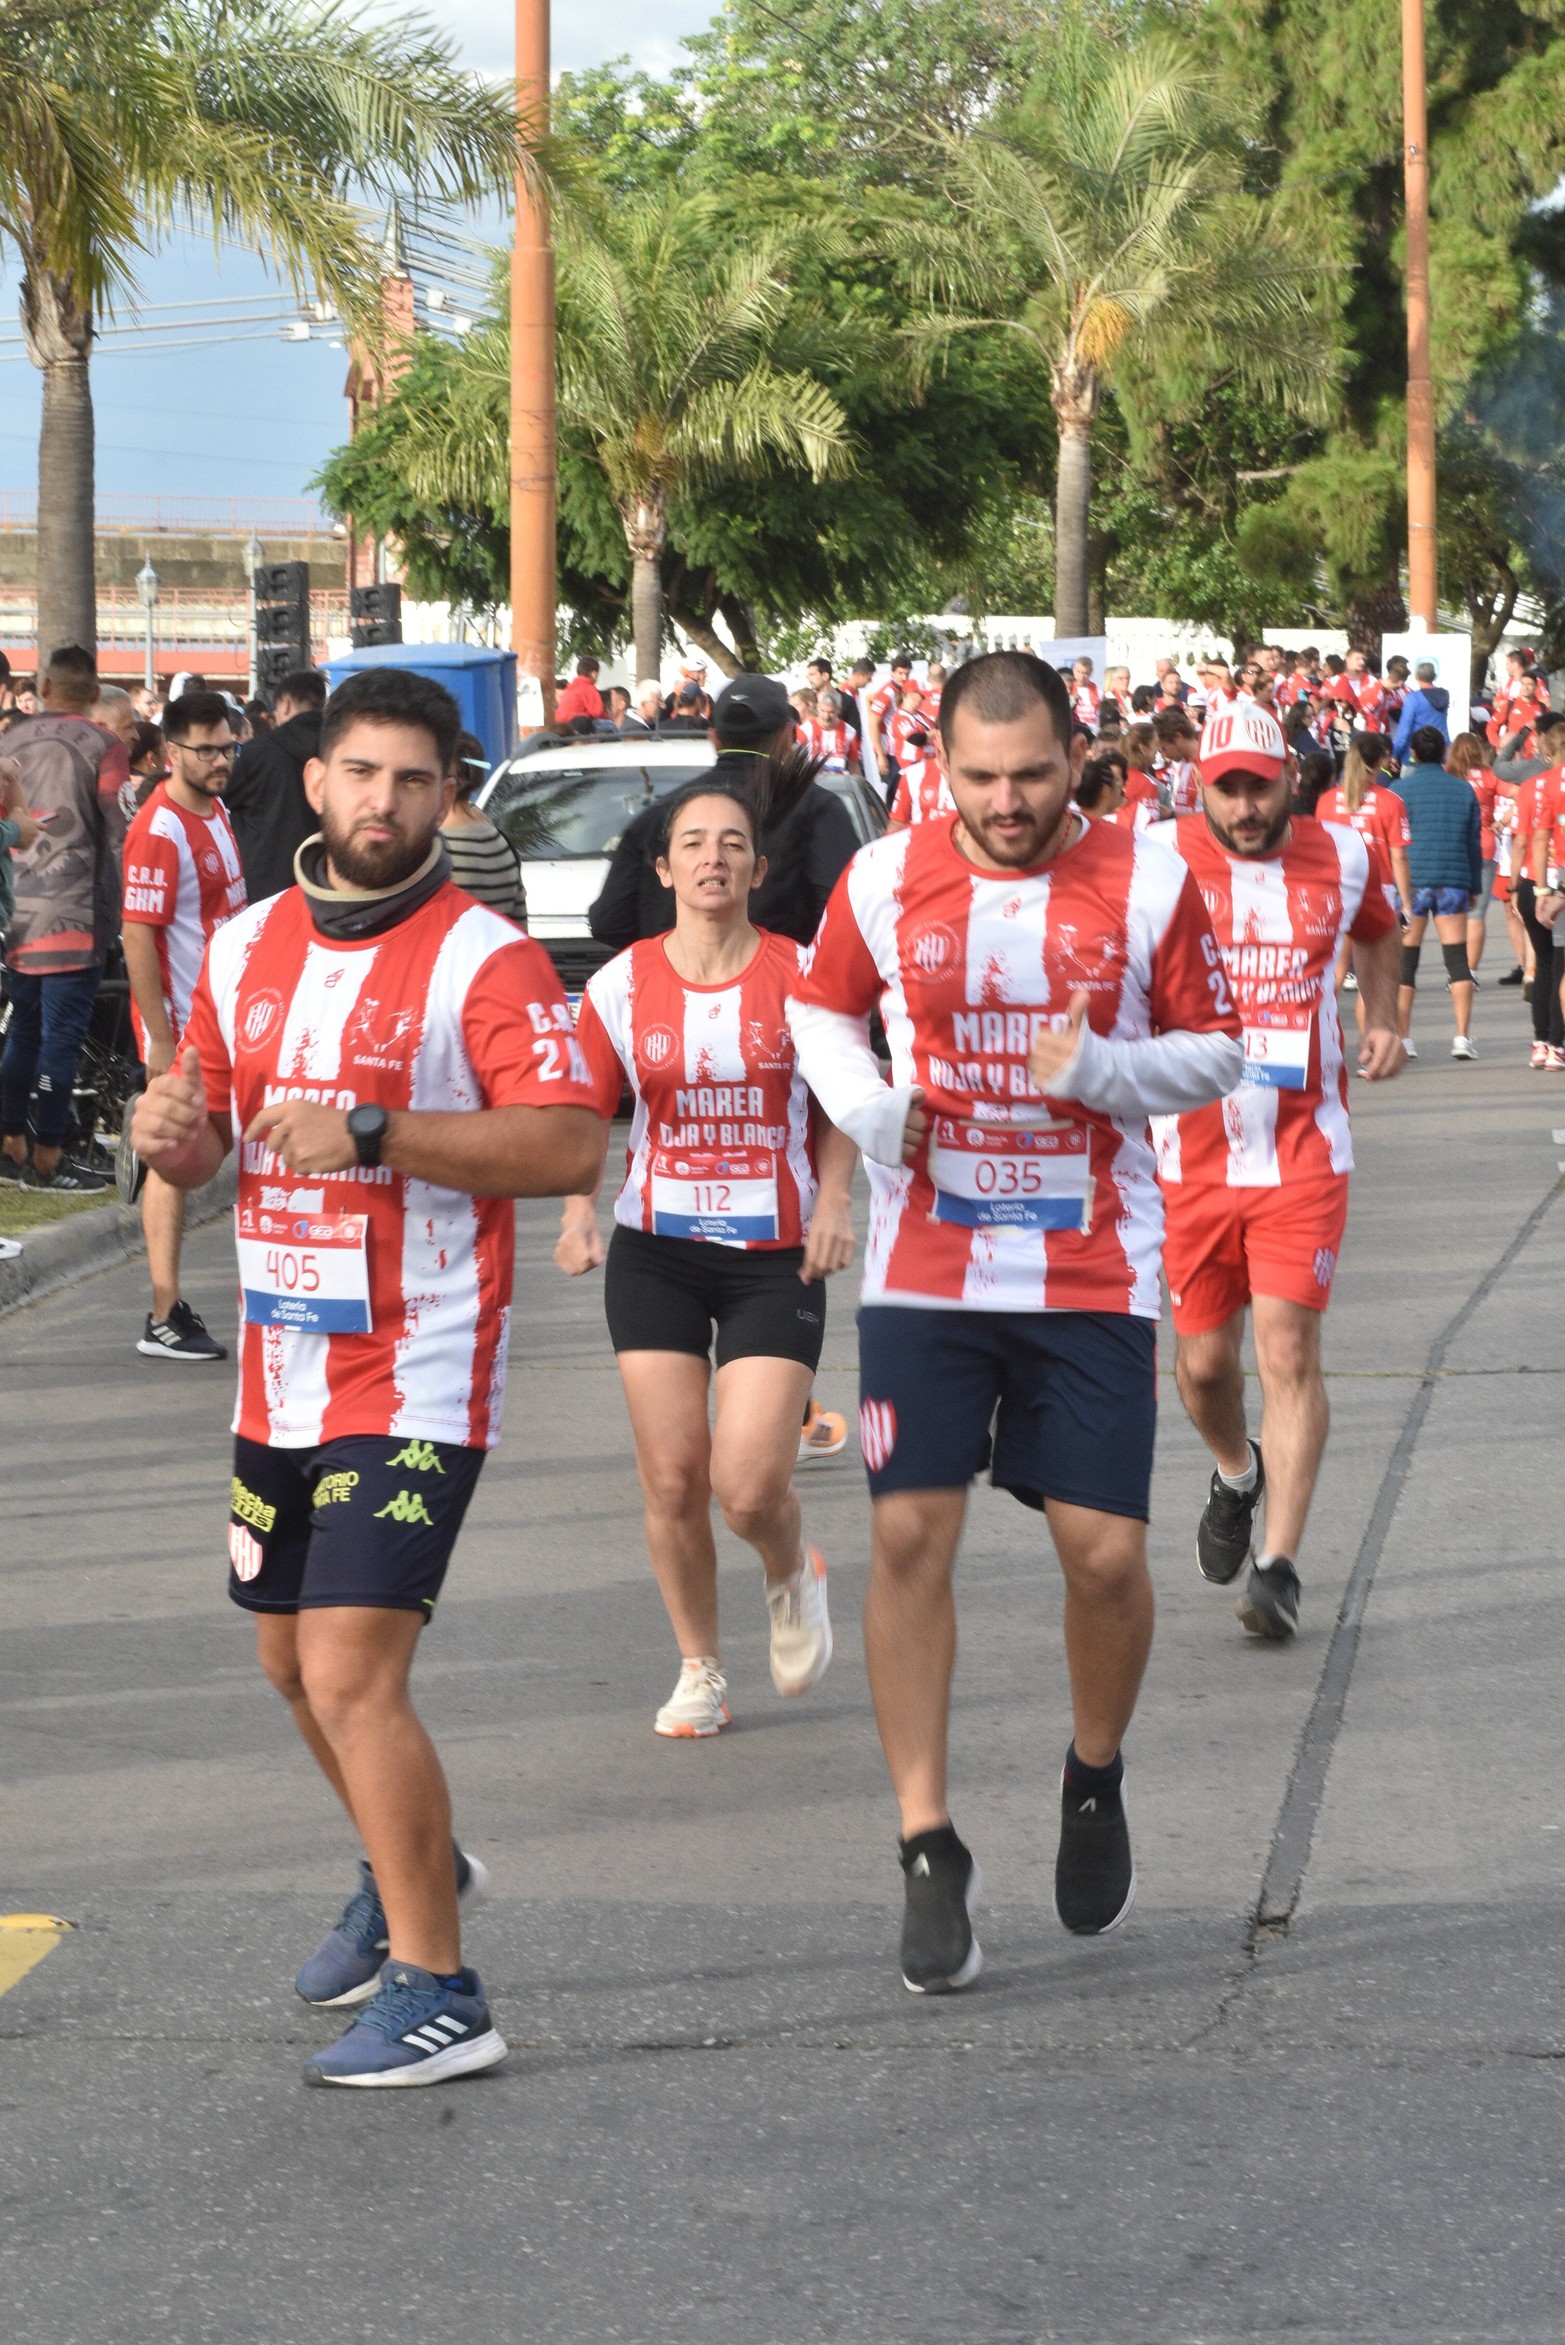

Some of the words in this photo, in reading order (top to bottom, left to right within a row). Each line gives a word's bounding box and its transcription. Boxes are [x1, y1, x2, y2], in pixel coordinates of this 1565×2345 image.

[1208, 716, 1234, 752] 10
[353, 1054, 387, 1068] SANTA
[388, 1057, 405, 1071] FE
[676, 1086, 764, 1118] MAREA
[658, 1121, 699, 1148] OJA
[703, 1122, 716, 1147] Y
[975, 1159, 1042, 1194] 035
[693, 1185, 731, 1212] 112
[266, 1249, 320, 1292] 405
[331, 1486, 351, 1502] FE
